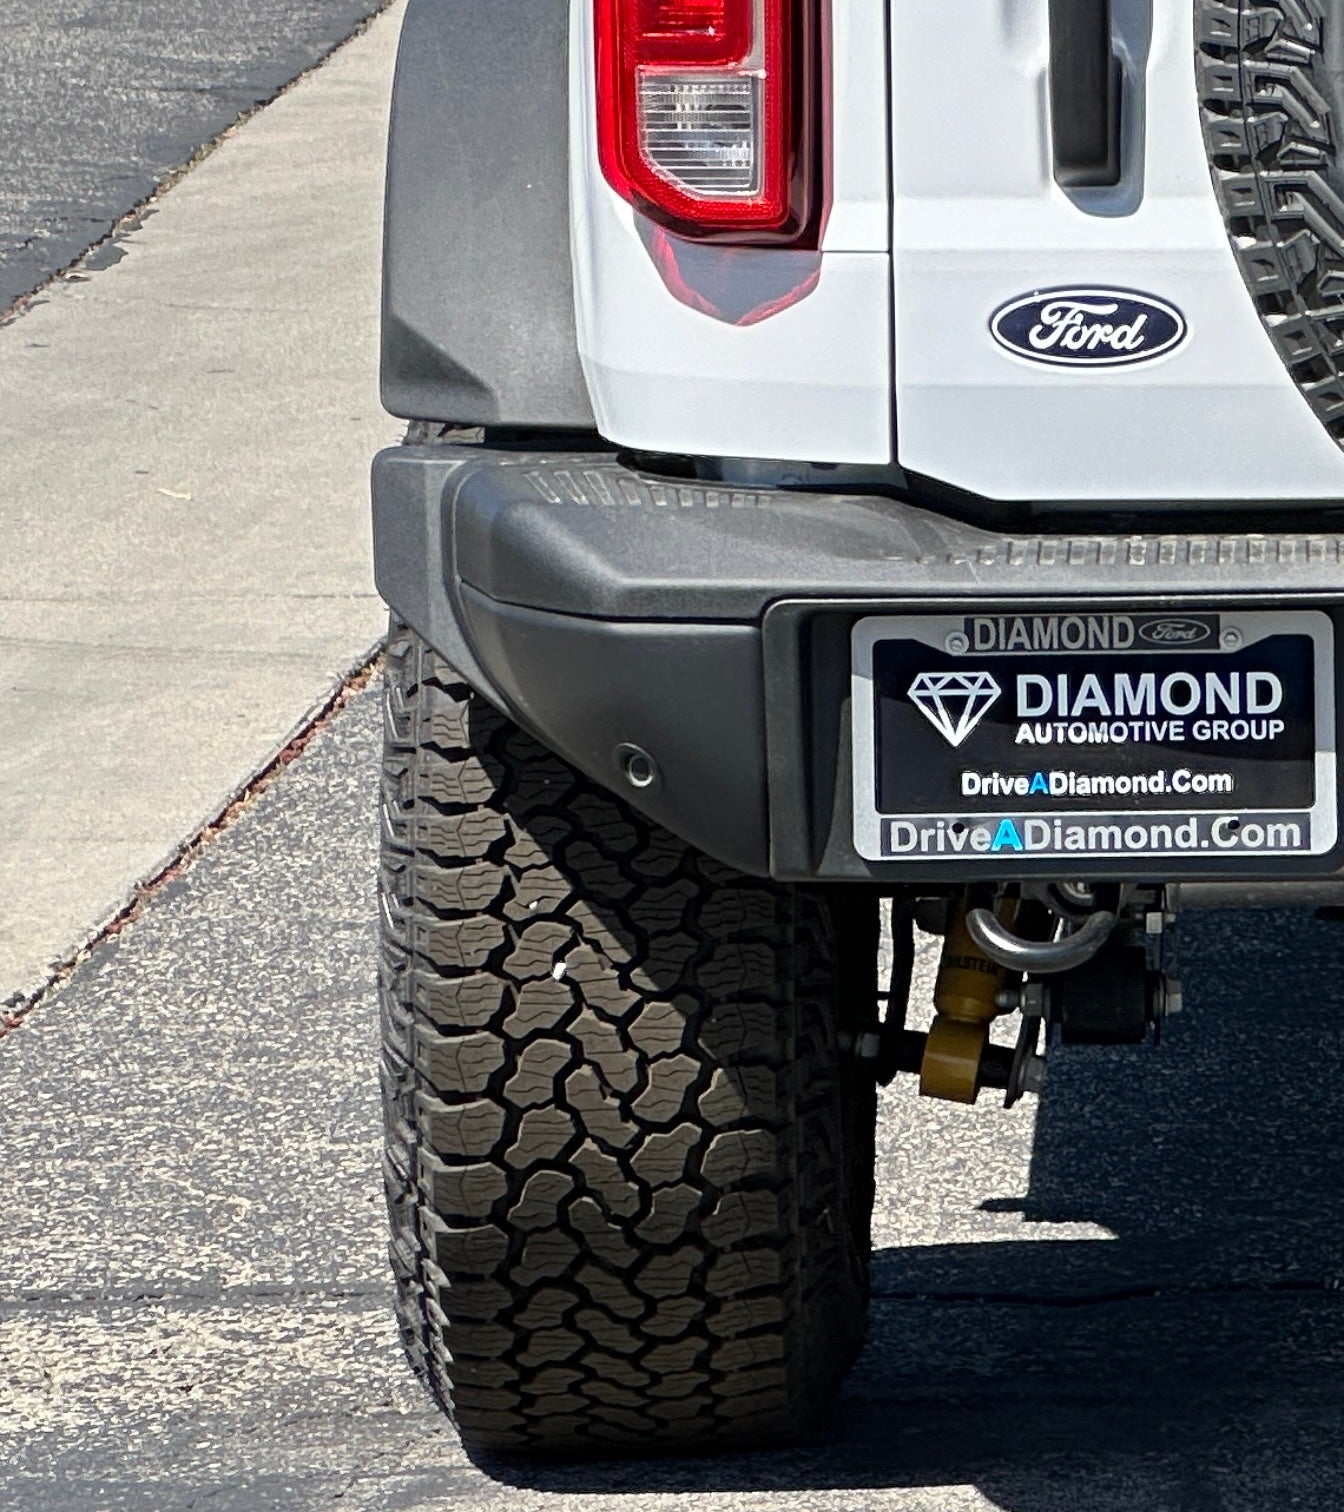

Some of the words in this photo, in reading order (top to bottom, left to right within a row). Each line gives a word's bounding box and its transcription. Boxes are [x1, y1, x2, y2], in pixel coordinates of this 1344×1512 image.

[1028, 300, 1149, 350] Ford
[973, 616, 1135, 652] DIAMOND
[1152, 622, 1198, 640] Ford
[1015, 672, 1284, 717] DIAMOND
[1014, 720, 1185, 745] AUTOMOTIVE
[1192, 719, 1285, 742] GROUP
[961, 769, 1233, 797] DriveADiamond.Com
[889, 816, 1301, 852] DriveADiamond.Com
